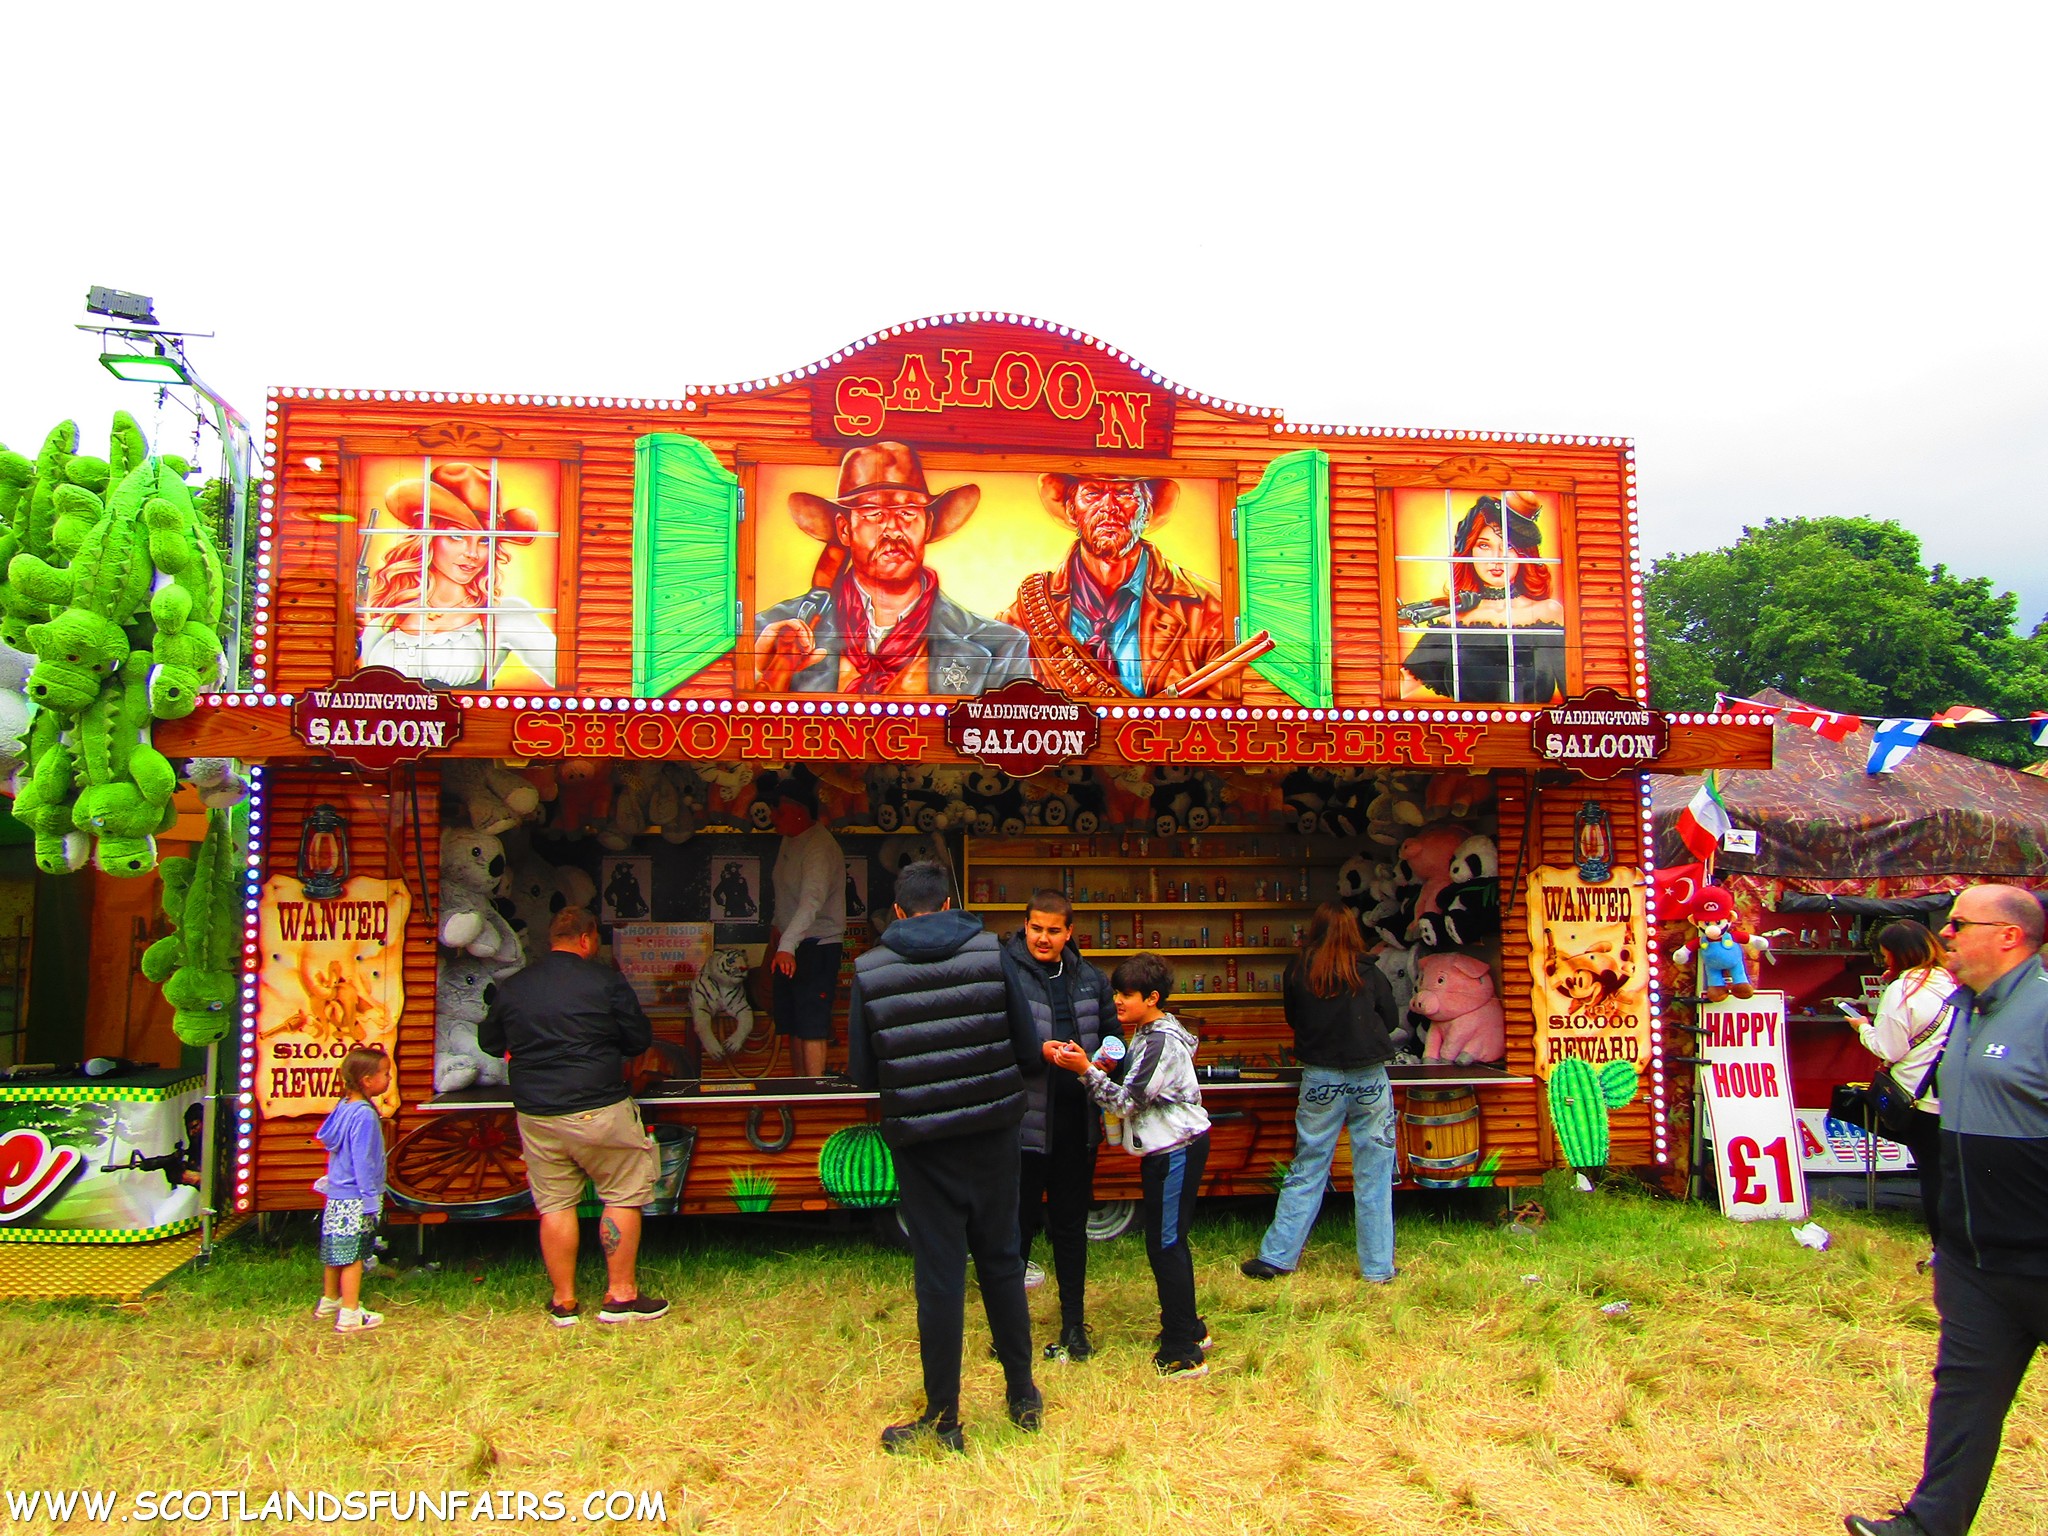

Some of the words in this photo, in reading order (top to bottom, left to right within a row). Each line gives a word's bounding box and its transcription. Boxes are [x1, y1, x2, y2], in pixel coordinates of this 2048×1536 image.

[834, 349, 1150, 449] SALOON
[313, 692, 438, 710] WADDINGTONS
[967, 703, 1079, 720] WADDINGTONS
[309, 718, 446, 746] SALOON
[1549, 710, 1649, 726] WADDINGTONS
[512, 711, 928, 759] SHOOTING
[1115, 720, 1488, 764] GALLERY
[962, 728, 1086, 755] SALOON
[1545, 733, 1656, 758] SALOON
[1542, 887, 1632, 923] WANTED
[277, 901, 388, 941] WANTED
[623, 926, 662, 936] SHOOT
[666, 926, 704, 936] INSIDE
[640, 951, 656, 961] TO
[660, 951, 685, 961] WIN
[646, 938, 692, 948] CIRCLES
[1706, 1013, 1778, 1047] HAPPY
[1548, 1036, 1639, 1064] REWARD
[271, 1067, 344, 1098] REWA
[1305, 1083, 1330, 1103] Ed
[1322, 1079, 1386, 1105] Hardy
[1712, 1063, 1779, 1098] HOUR
[1727, 1136, 1794, 1204] £1
